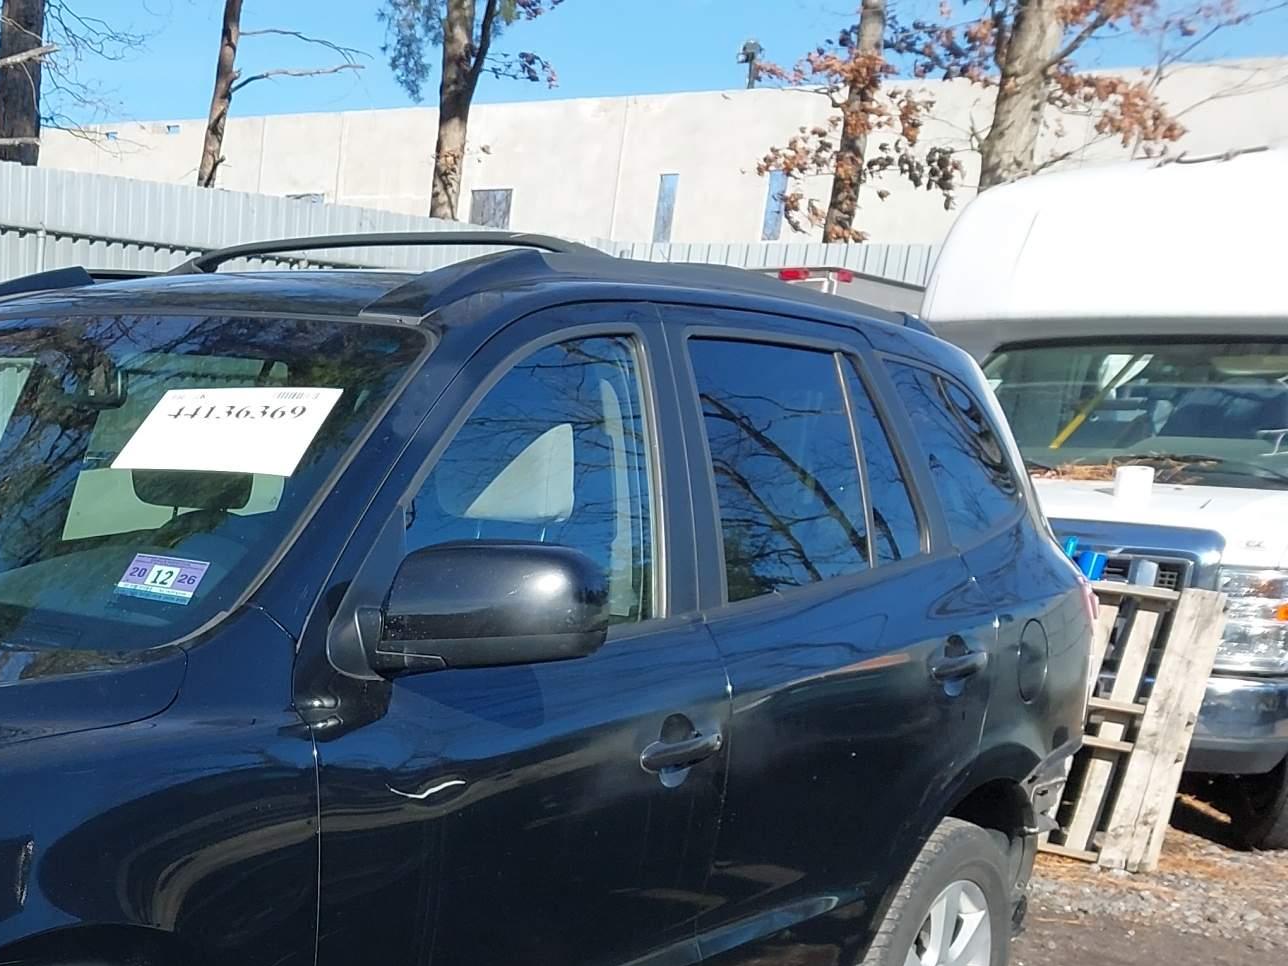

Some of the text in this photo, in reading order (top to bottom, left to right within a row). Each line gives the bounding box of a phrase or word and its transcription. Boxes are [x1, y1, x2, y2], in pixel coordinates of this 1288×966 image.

[168, 405, 307, 420] 44136369
[129, 566, 198, 586] 20 12 26
